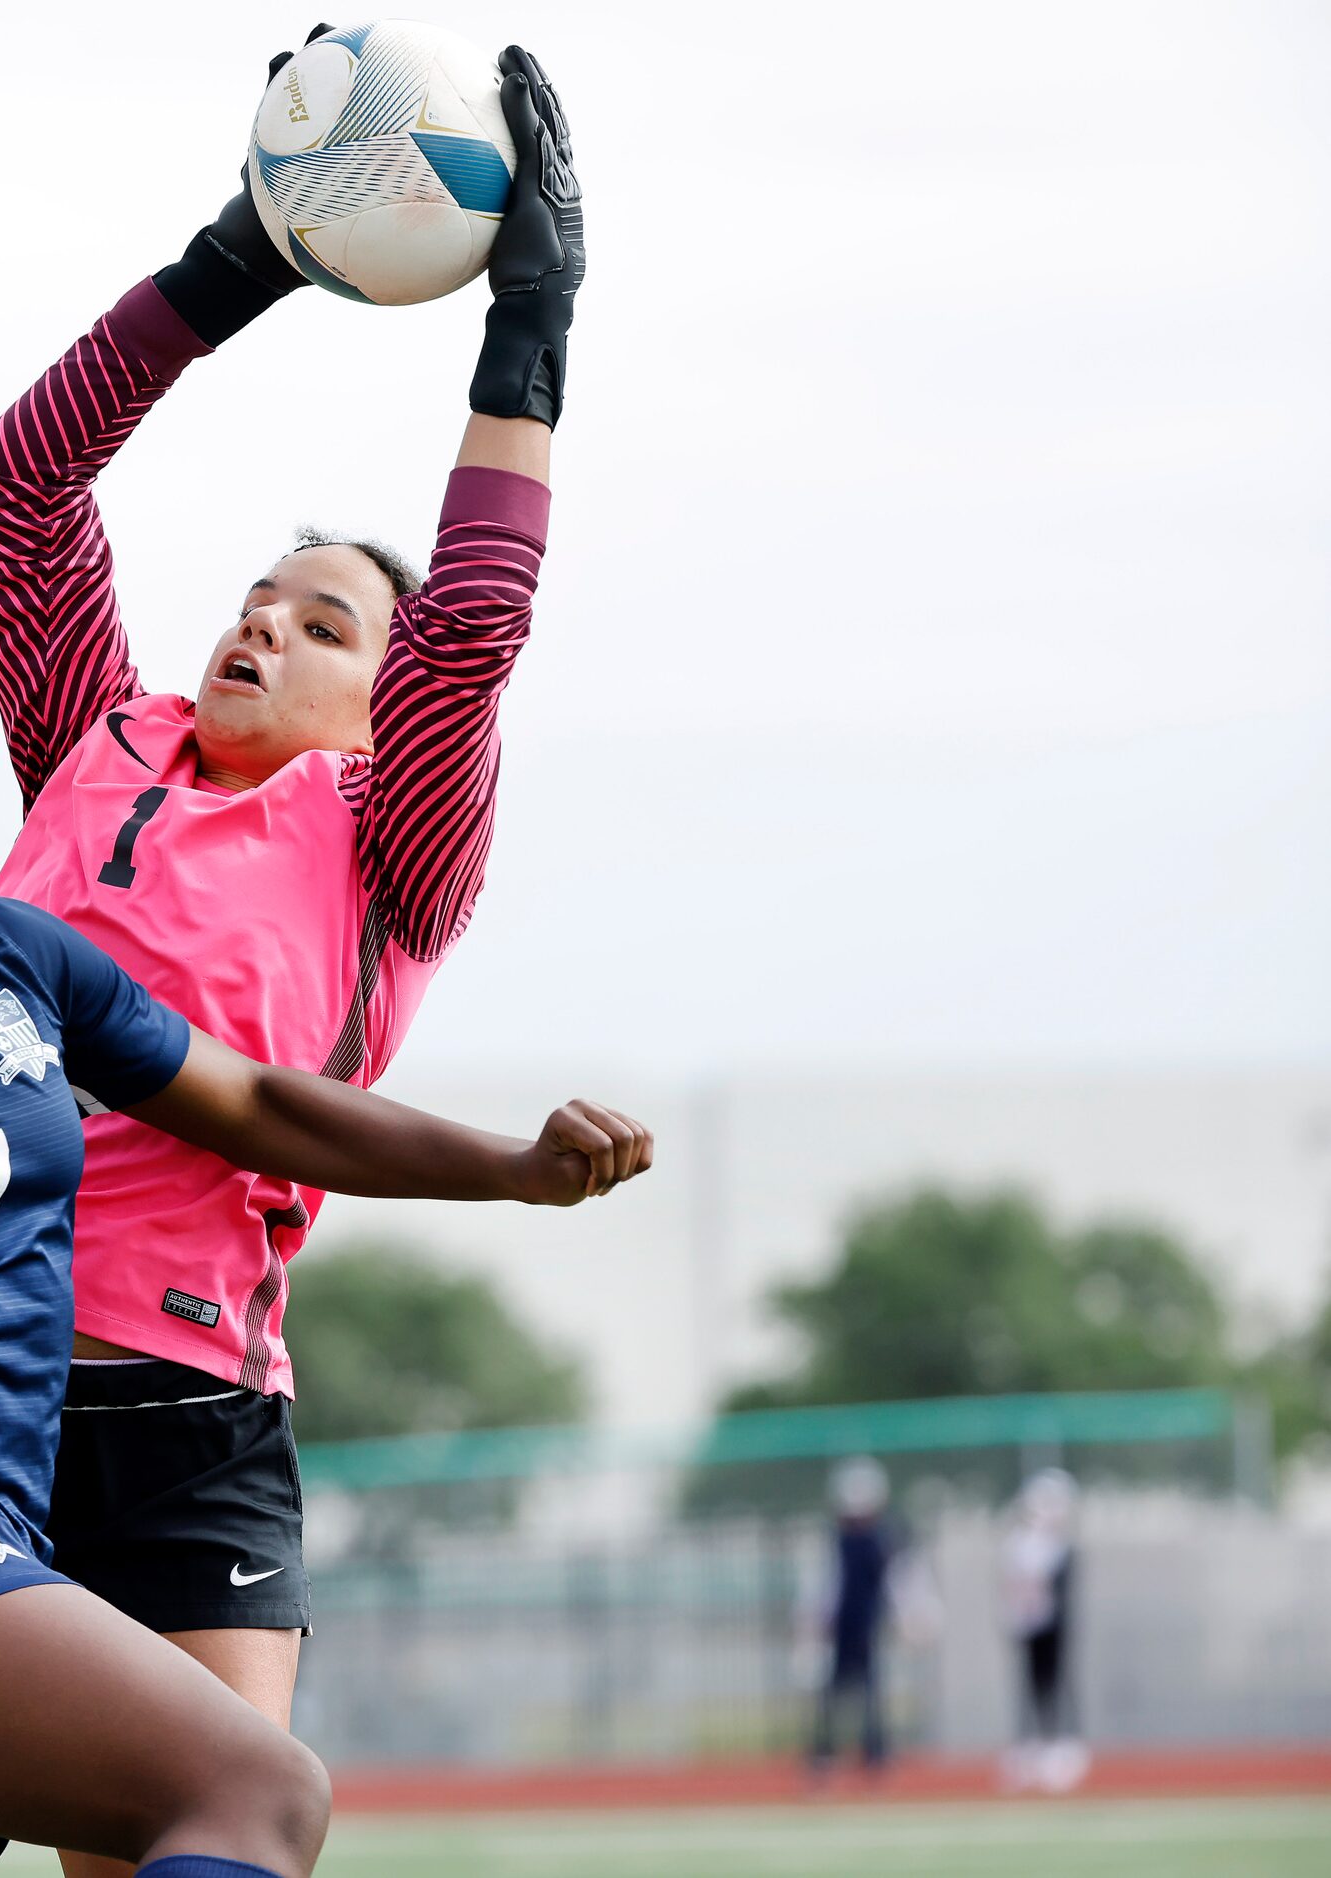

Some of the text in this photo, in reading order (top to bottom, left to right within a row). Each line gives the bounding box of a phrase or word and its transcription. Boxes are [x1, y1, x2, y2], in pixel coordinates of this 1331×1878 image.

[97, 785, 169, 890] 1
[169, 1293, 202, 1309] AUTHENTIC
[166, 1303, 200, 1319] SOCCER
